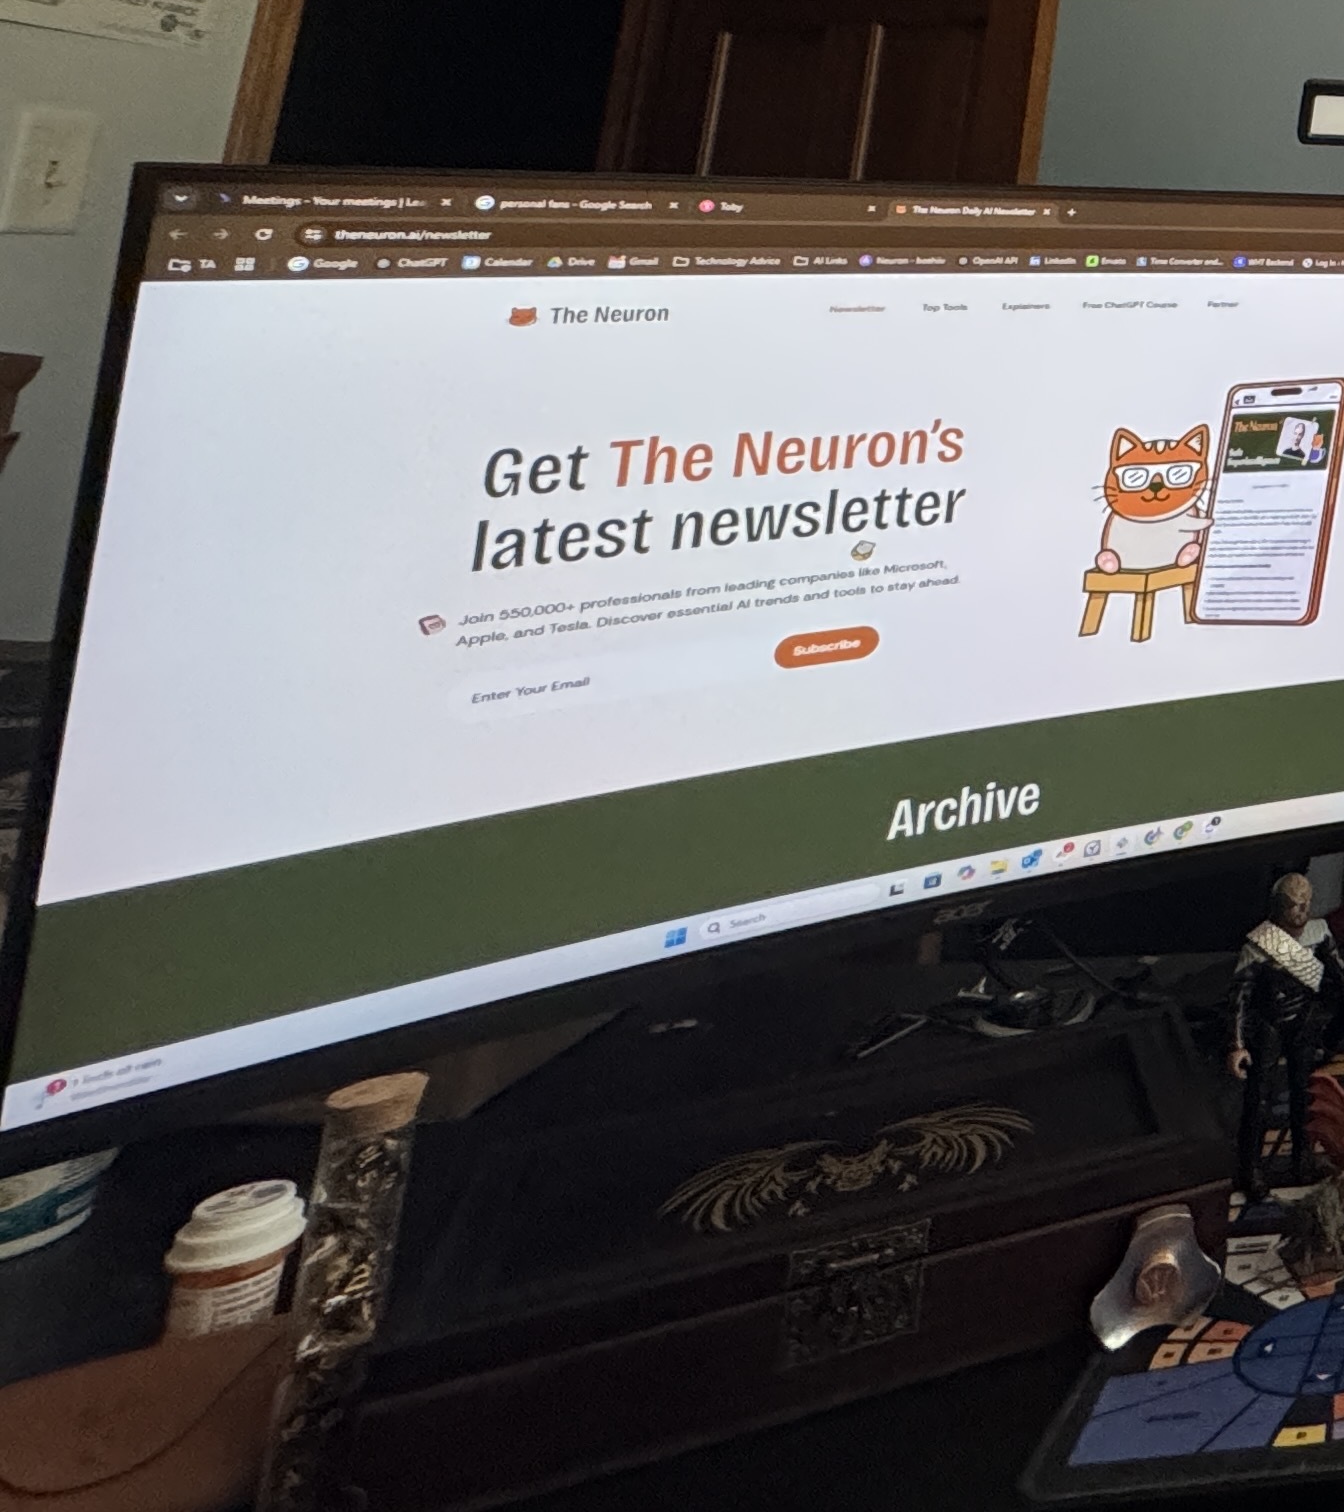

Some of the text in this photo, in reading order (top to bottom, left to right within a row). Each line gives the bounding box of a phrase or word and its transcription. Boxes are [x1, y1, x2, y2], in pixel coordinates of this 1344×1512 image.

[243, 195, 396, 209] Meetings Your meetings
[579, 200, 652, 212] Google Search
[720, 201, 744, 214] Toby
[335, 228, 492, 243] theneuron.ai/newsletter
[199, 259, 217, 269] TA
[314, 258, 358, 271] Google
[398, 257, 448, 269] ChatGPT
[485, 257, 533, 268] Calendar
[568, 257, 595, 267] Drive
[829, 304, 885, 314] Newsletter
[922, 302, 968, 314] Top Tools
[1002, 301, 1051, 312] Explainers
[1105, 300, 1178, 310] ChatGPT Course
[551, 305, 669, 324] The Neuron
[484, 418, 964, 499] Get The Neuron's
[471, 487, 967, 572] latest newsletter
[457, 559, 948, 627] Join 550,000+ professionals from leading companies like Microsoft,
[455, 579, 915, 648] Apple, and Discover essential AI trends and tools to stay
[792, 637, 861, 657] Subscribe
[471, 676, 590, 704] Enter Your Email
[887, 782, 1041, 840] Archive
